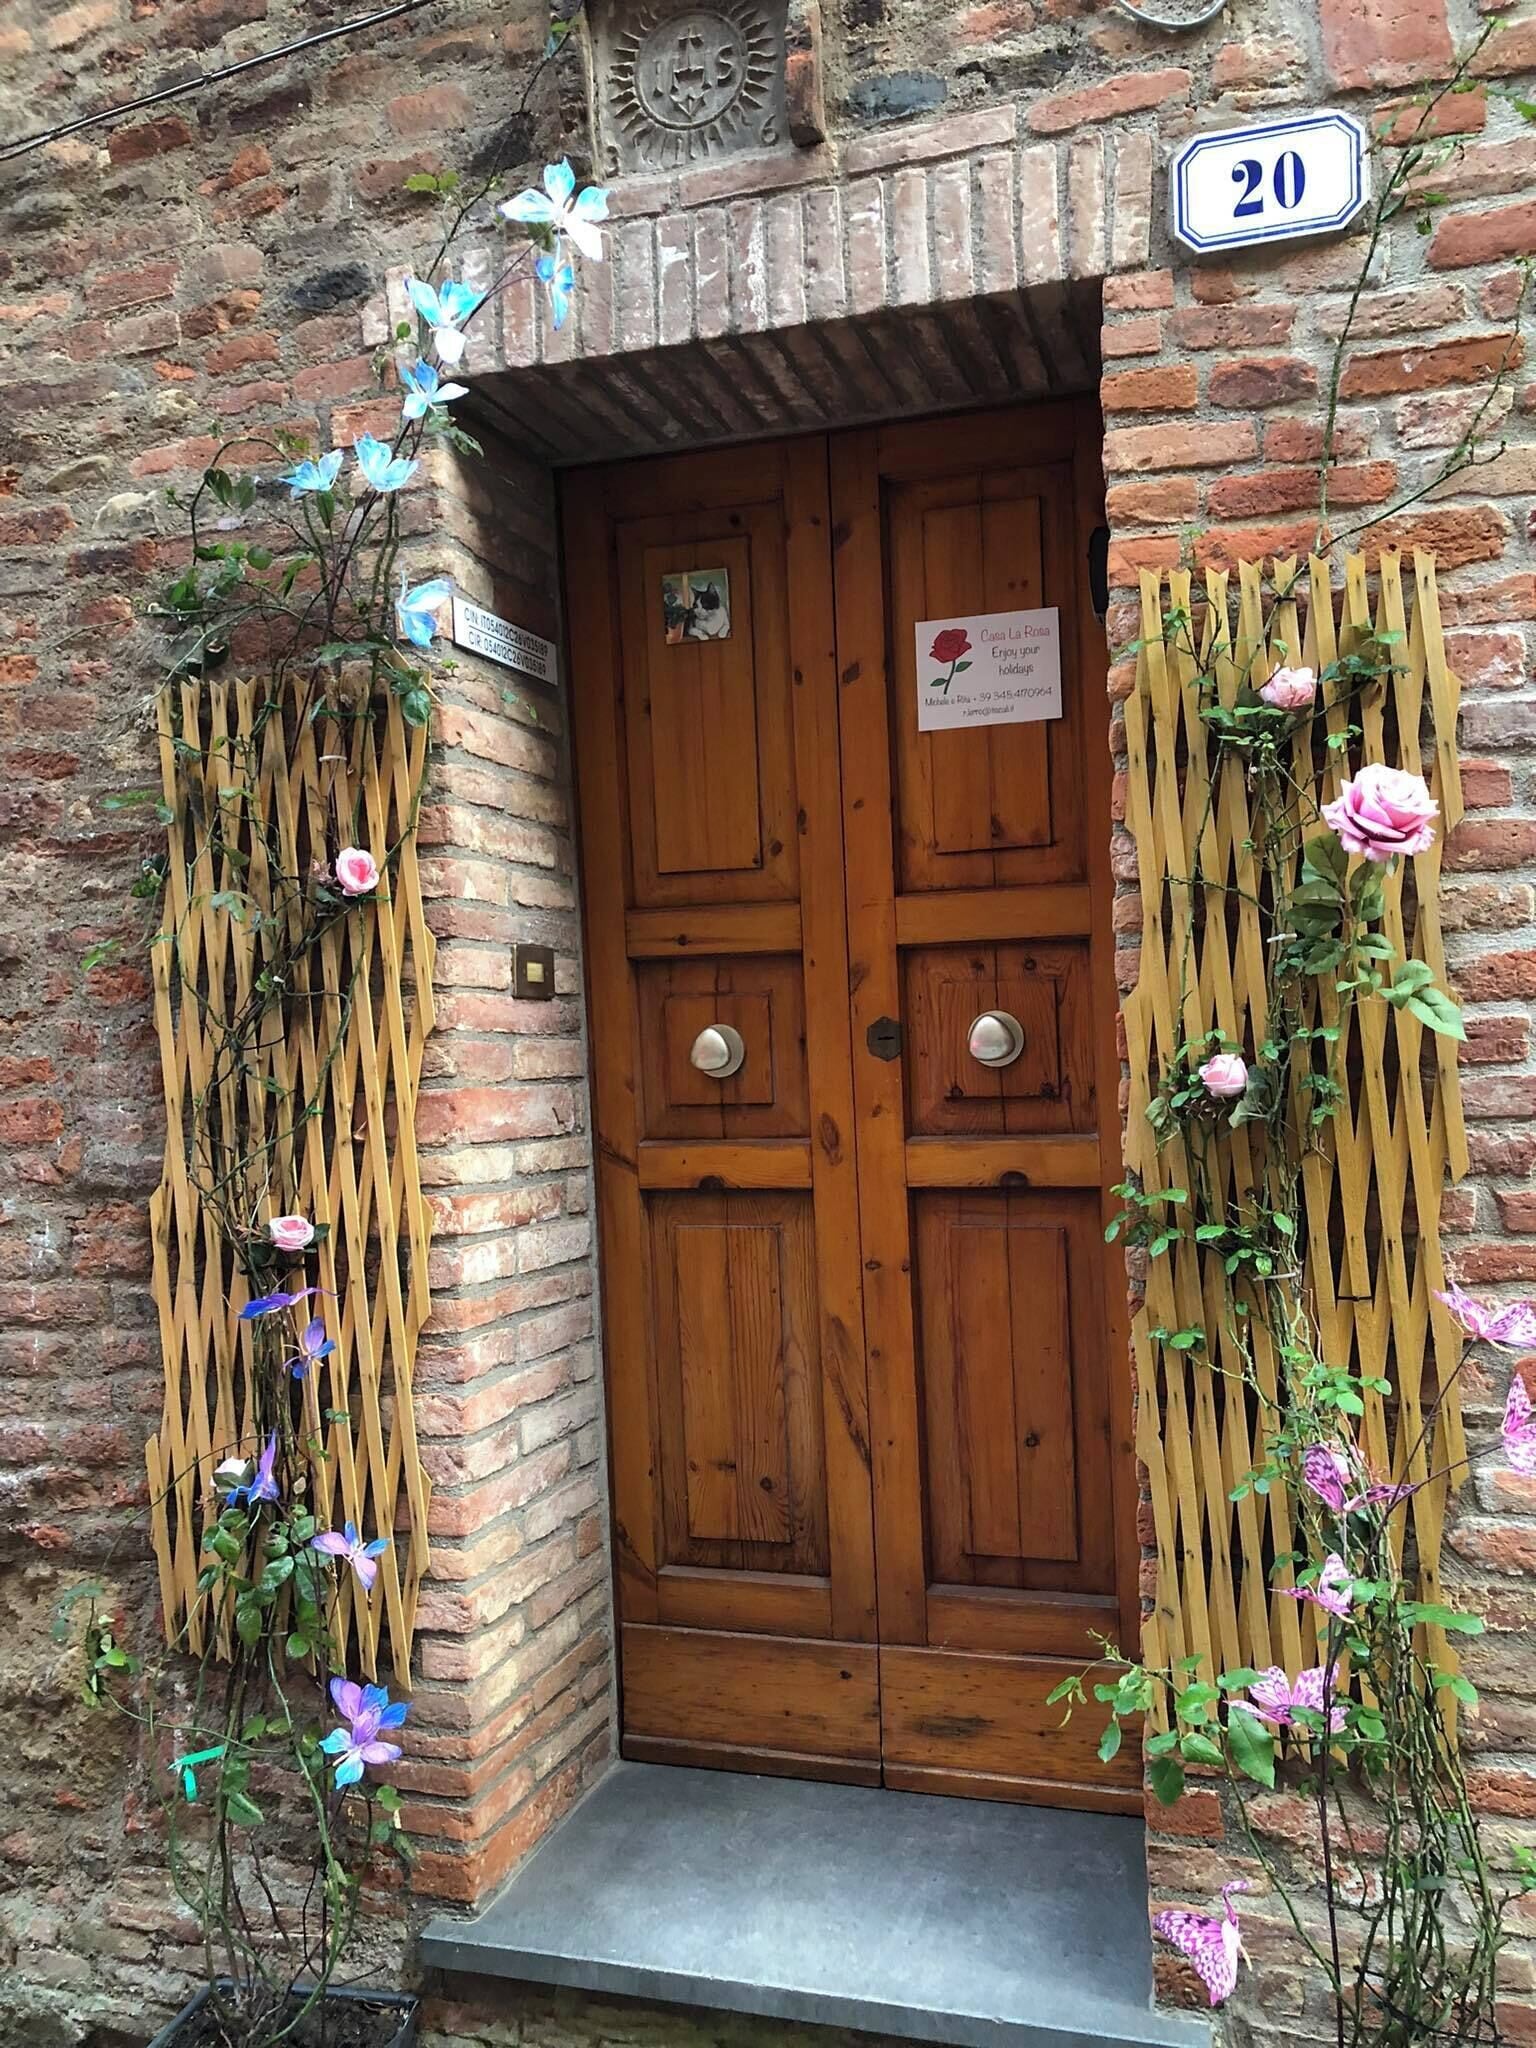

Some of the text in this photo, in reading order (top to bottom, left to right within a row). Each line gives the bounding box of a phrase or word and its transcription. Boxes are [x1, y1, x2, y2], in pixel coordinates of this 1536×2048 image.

[1231, 151, 1306, 217] 20
[980, 625, 1050, 642] Casa La Rosa
[991, 646, 1041, 661] Enjoy your
[998, 663, 1035, 677] holidays
